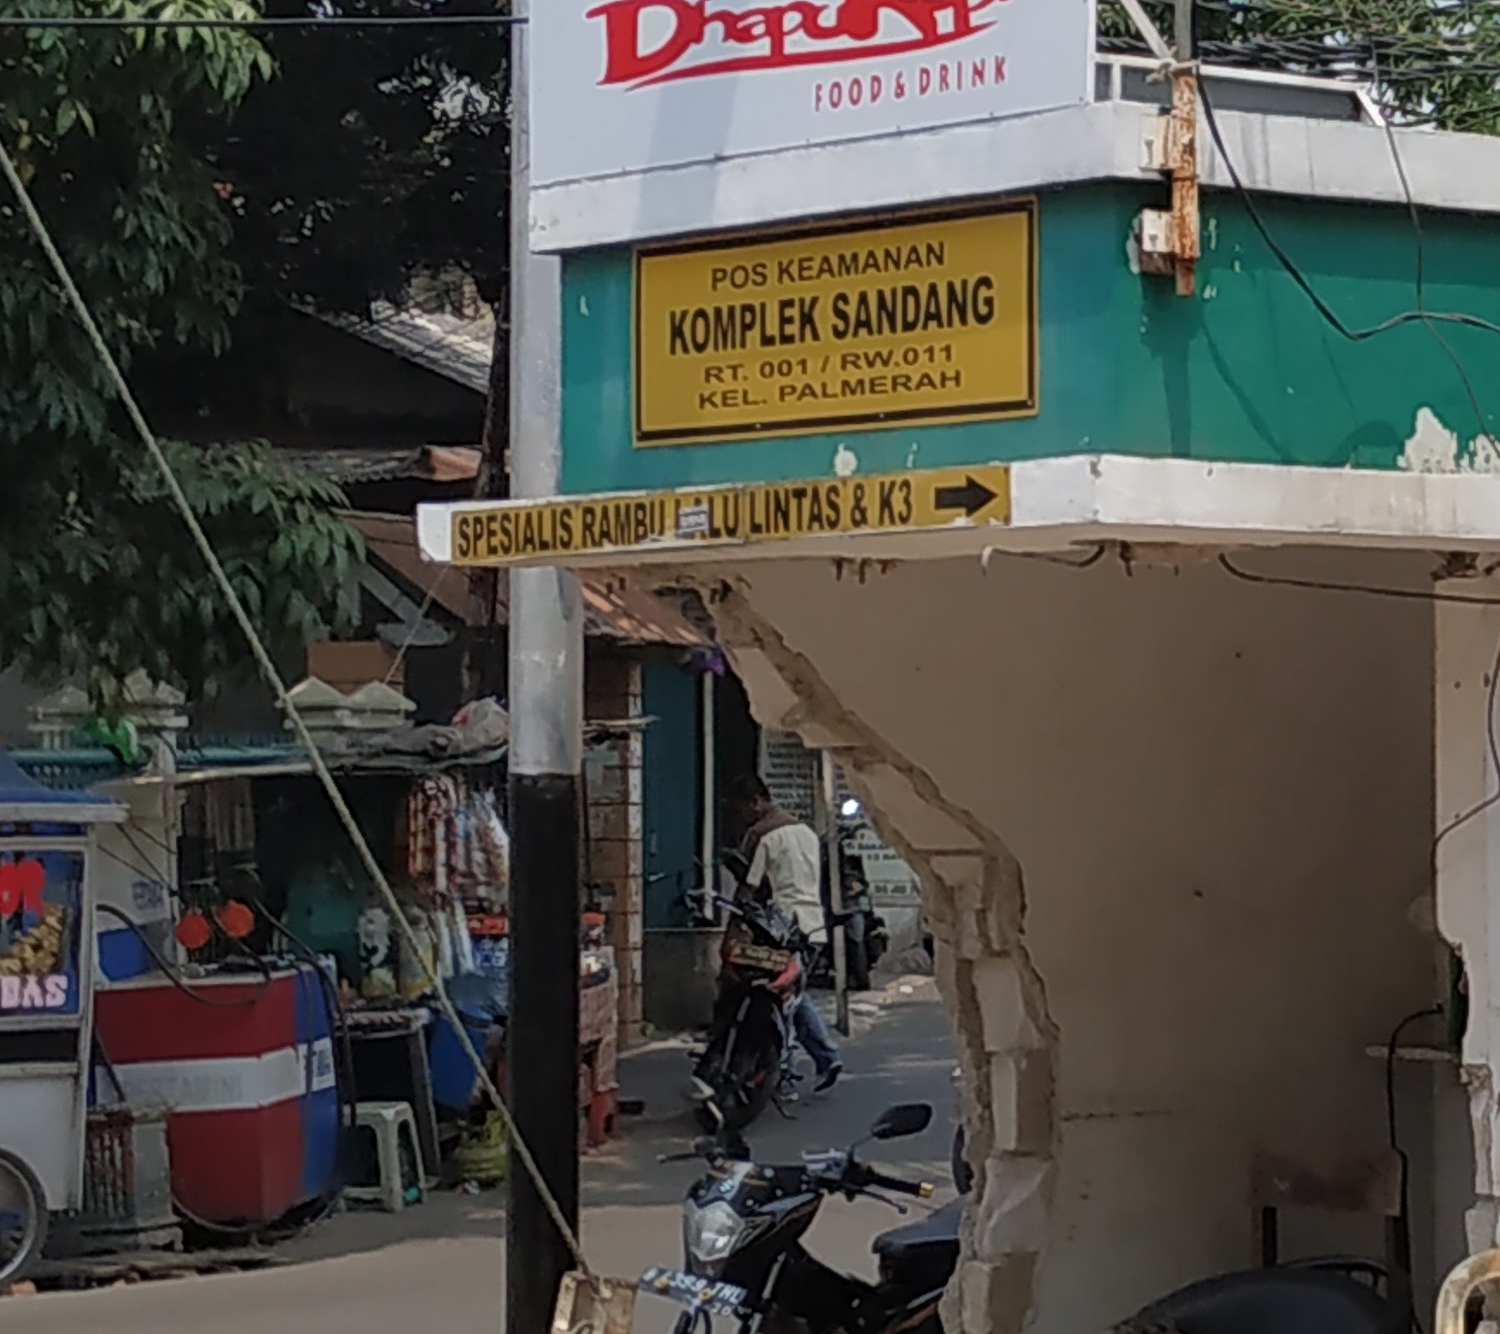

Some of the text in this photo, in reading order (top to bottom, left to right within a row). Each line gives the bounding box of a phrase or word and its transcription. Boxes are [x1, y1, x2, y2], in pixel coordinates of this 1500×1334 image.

[815, 56, 1008, 112] FOOD & DRINK
[711, 241, 945, 291] POS KEAMANAN
[669, 275, 995, 355] KOMPLEK SANDANG
[698, 369, 962, 410] KEL. PALMERAH
[704, 364, 749, 384] RT.
[758, 357, 809, 380] 001
[840, 344, 954, 372] RW.011
[457, 507, 573, 558] SPESIALIS
[581, 498, 665, 548] RAMBU
[750, 483, 842, 535] LINTAS
[852, 482, 869, 529] &
[878, 477, 914, 527] K3
